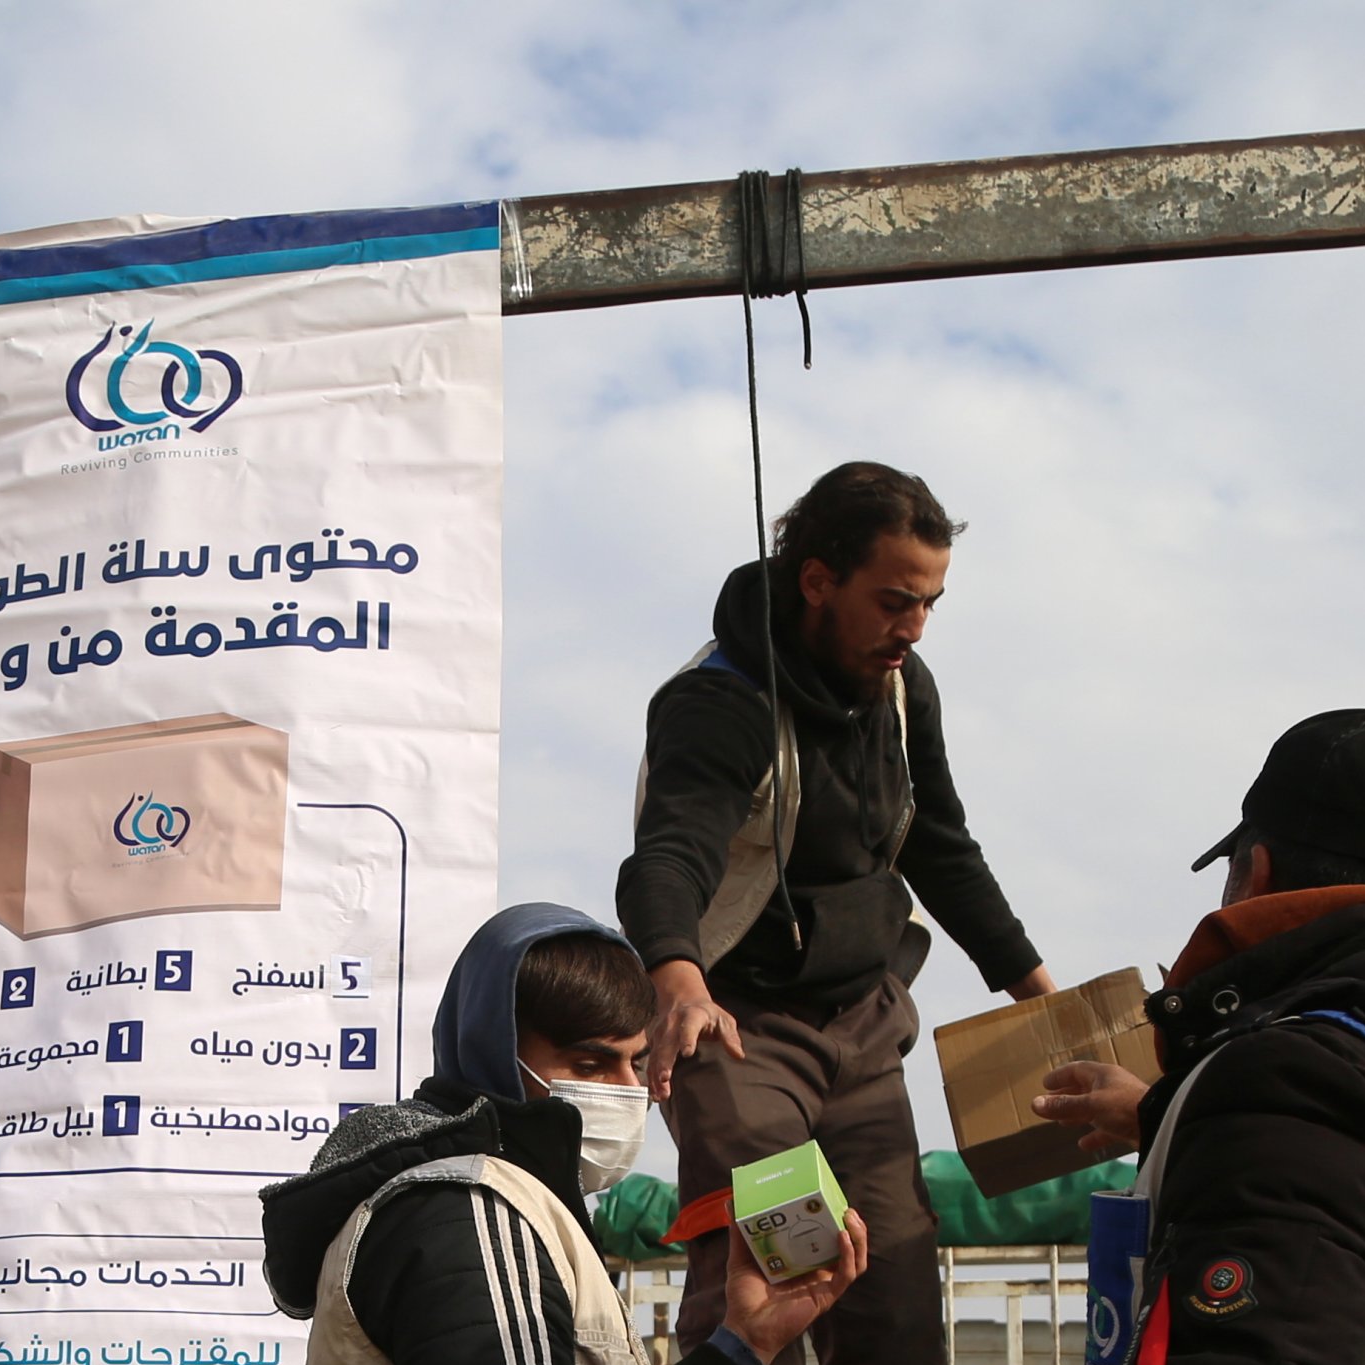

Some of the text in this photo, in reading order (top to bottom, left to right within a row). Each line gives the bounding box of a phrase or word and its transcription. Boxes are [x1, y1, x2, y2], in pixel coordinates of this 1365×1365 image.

[60, 446, 239, 475] Reviving Communities
[102, 539, 210, 584] سلة
[229, 528, 419, 582] محتوى
[145, 600, 390, 657] المقدمة
[48, 625, 123, 675] من
[8, 975, 28, 1001] 2
[66, 955, 183, 996] 5 بطانية
[232, 962, 361, 996] 5 اسفنج
[190, 1031, 367, 1067] 2 بدون مياه
[53, 1106, 94, 1138] بيل
[150, 1106, 330, 1141] مواد مطبخية
[744, 1213, 787, 1236] LED
[98, 1261, 244, 1288] الخدمات
